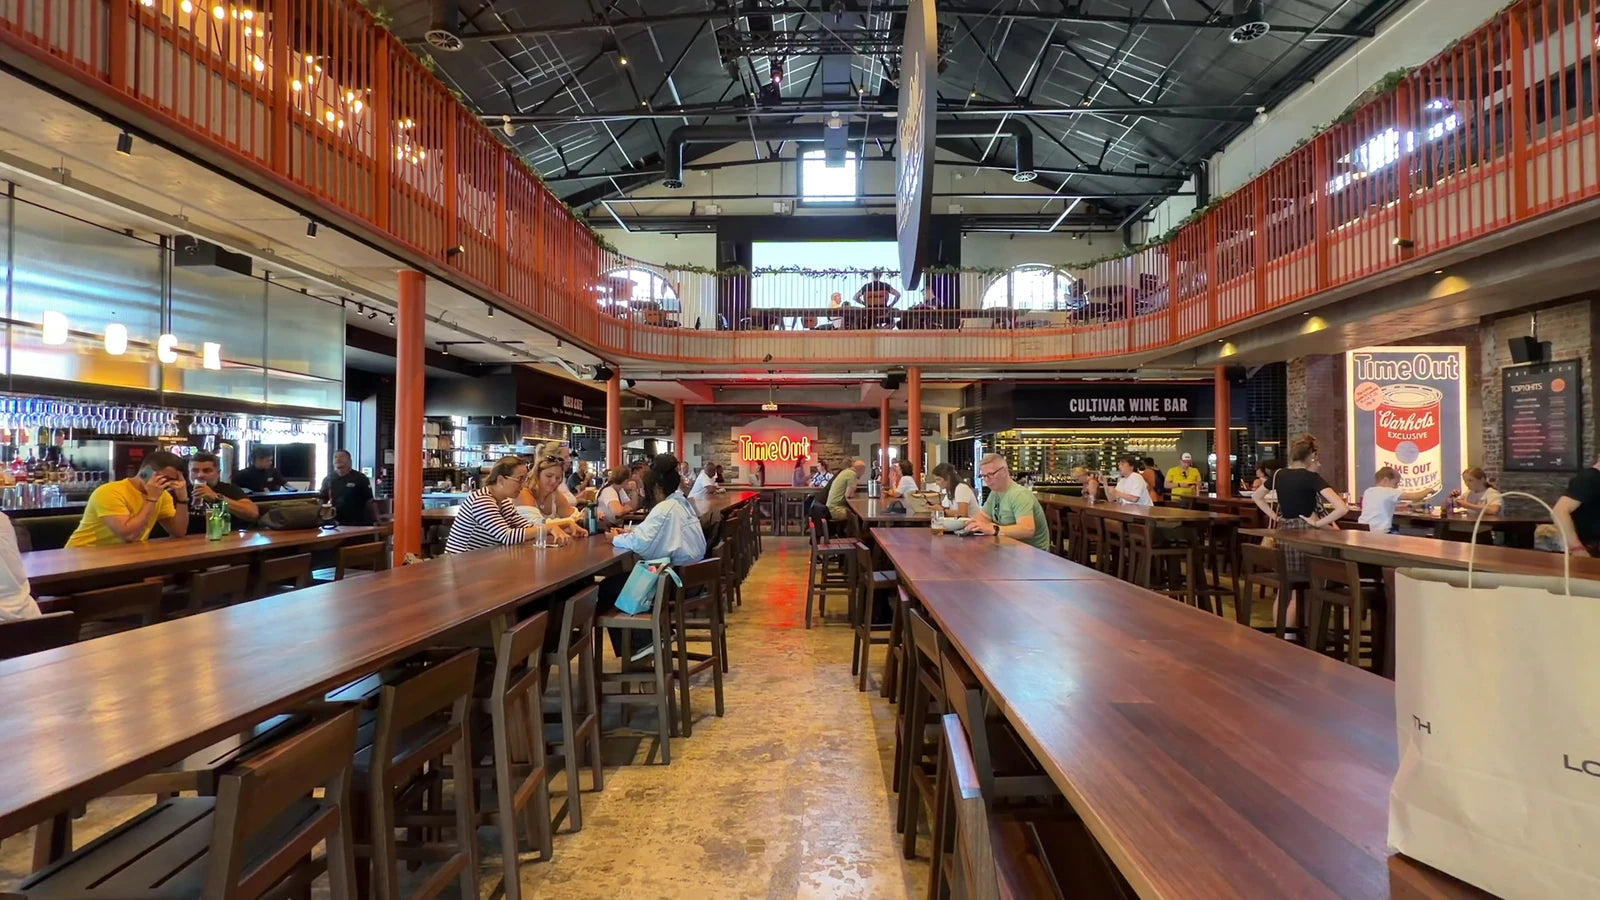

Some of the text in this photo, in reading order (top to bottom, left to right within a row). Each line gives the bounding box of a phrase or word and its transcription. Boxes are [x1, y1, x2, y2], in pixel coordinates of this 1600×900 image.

[1069, 398, 1188, 412] CULTIVAR WINE BAR
[1387, 431, 1428, 440] EXCLUSIVE
[1412, 462, 1432, 475] OUT
